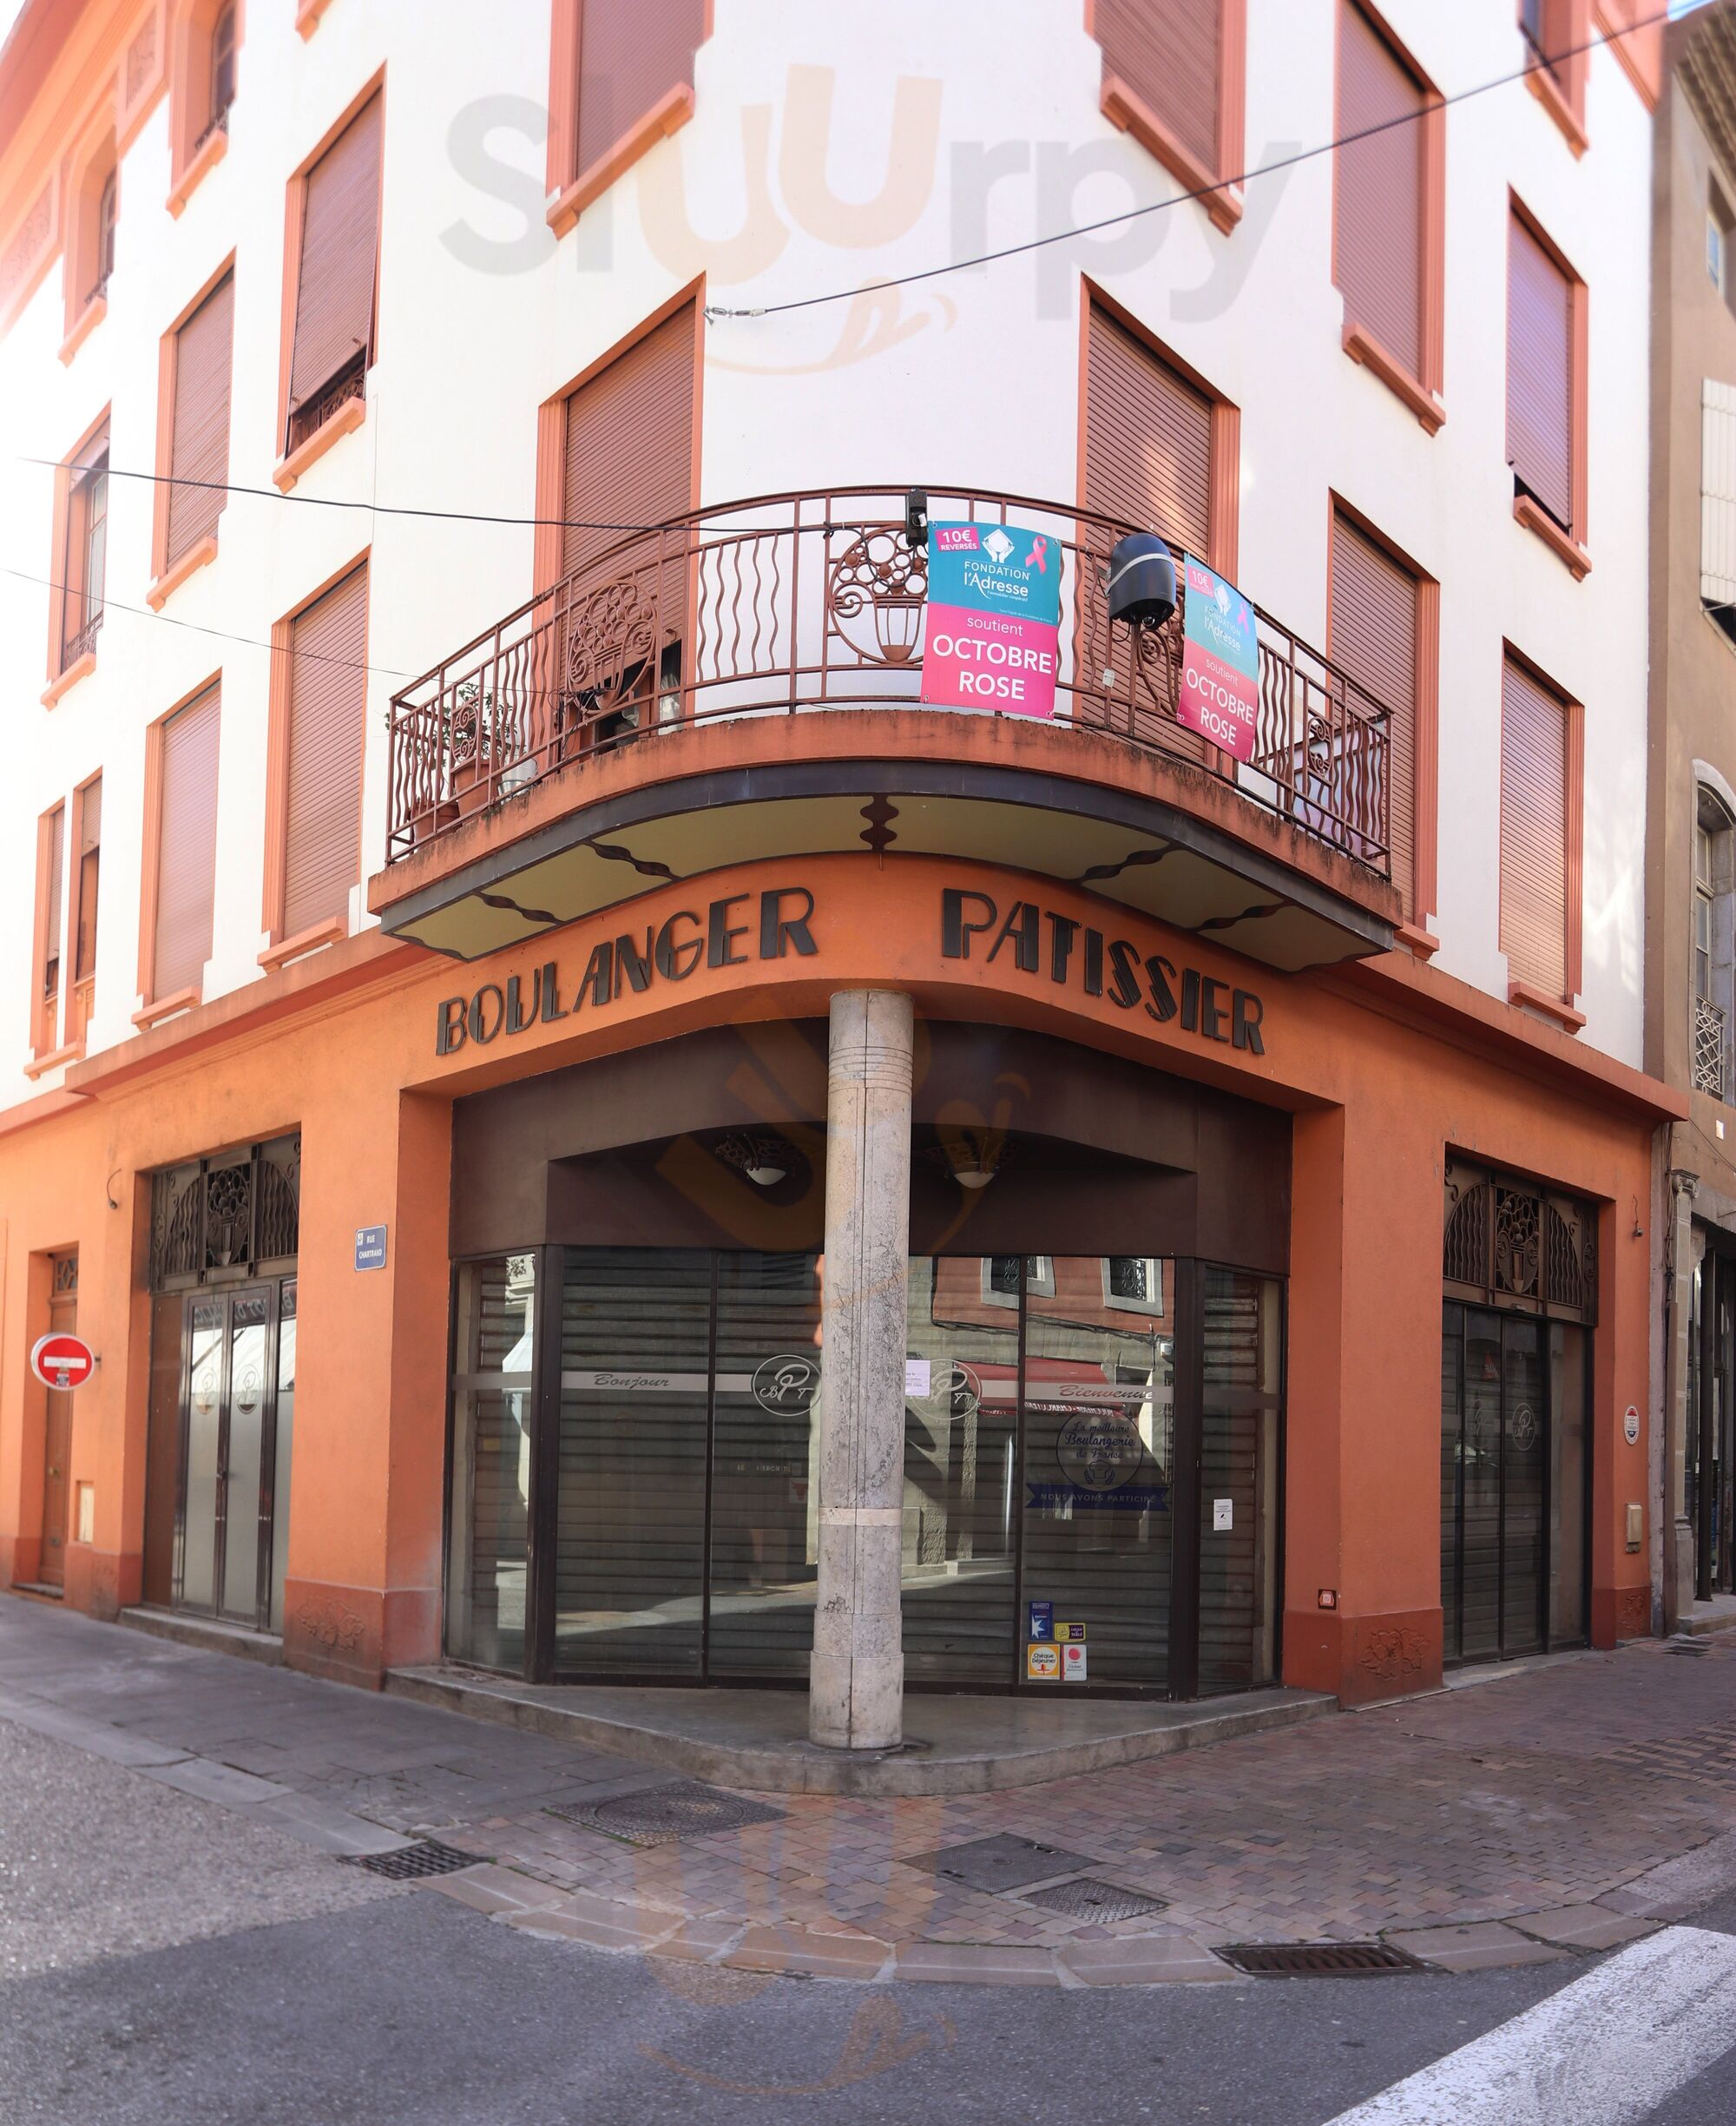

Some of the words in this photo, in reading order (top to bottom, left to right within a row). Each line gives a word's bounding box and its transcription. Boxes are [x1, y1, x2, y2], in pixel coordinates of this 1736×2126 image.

[942, 530, 973, 543] 10€
[964, 561, 1030, 582] FONDATION
[964, 571, 1029, 600] l'Adresse
[1192, 569, 1209, 589] 10€
[966, 617, 1024, 637] soutient
[1204, 615, 1242, 651] l'Adresse
[932, 634, 1052, 674] OCTOBRE
[958, 671, 1025, 701] ROSE
[1205, 657, 1239, 687] soutient
[1186, 668, 1254, 726] OCTOBRE
[1200, 706, 1237, 747] ROSE
[436, 886, 819, 1056] BOULANGER
[942, 888, 1266, 1056] PATISSIER
[366, 1234, 376, 1243] RUE
[594, 1372, 670, 1389] Bonjour
[1058, 1384, 1154, 1399] Bienvenue
[1064, 1432, 1135, 1449] Boulangerie
